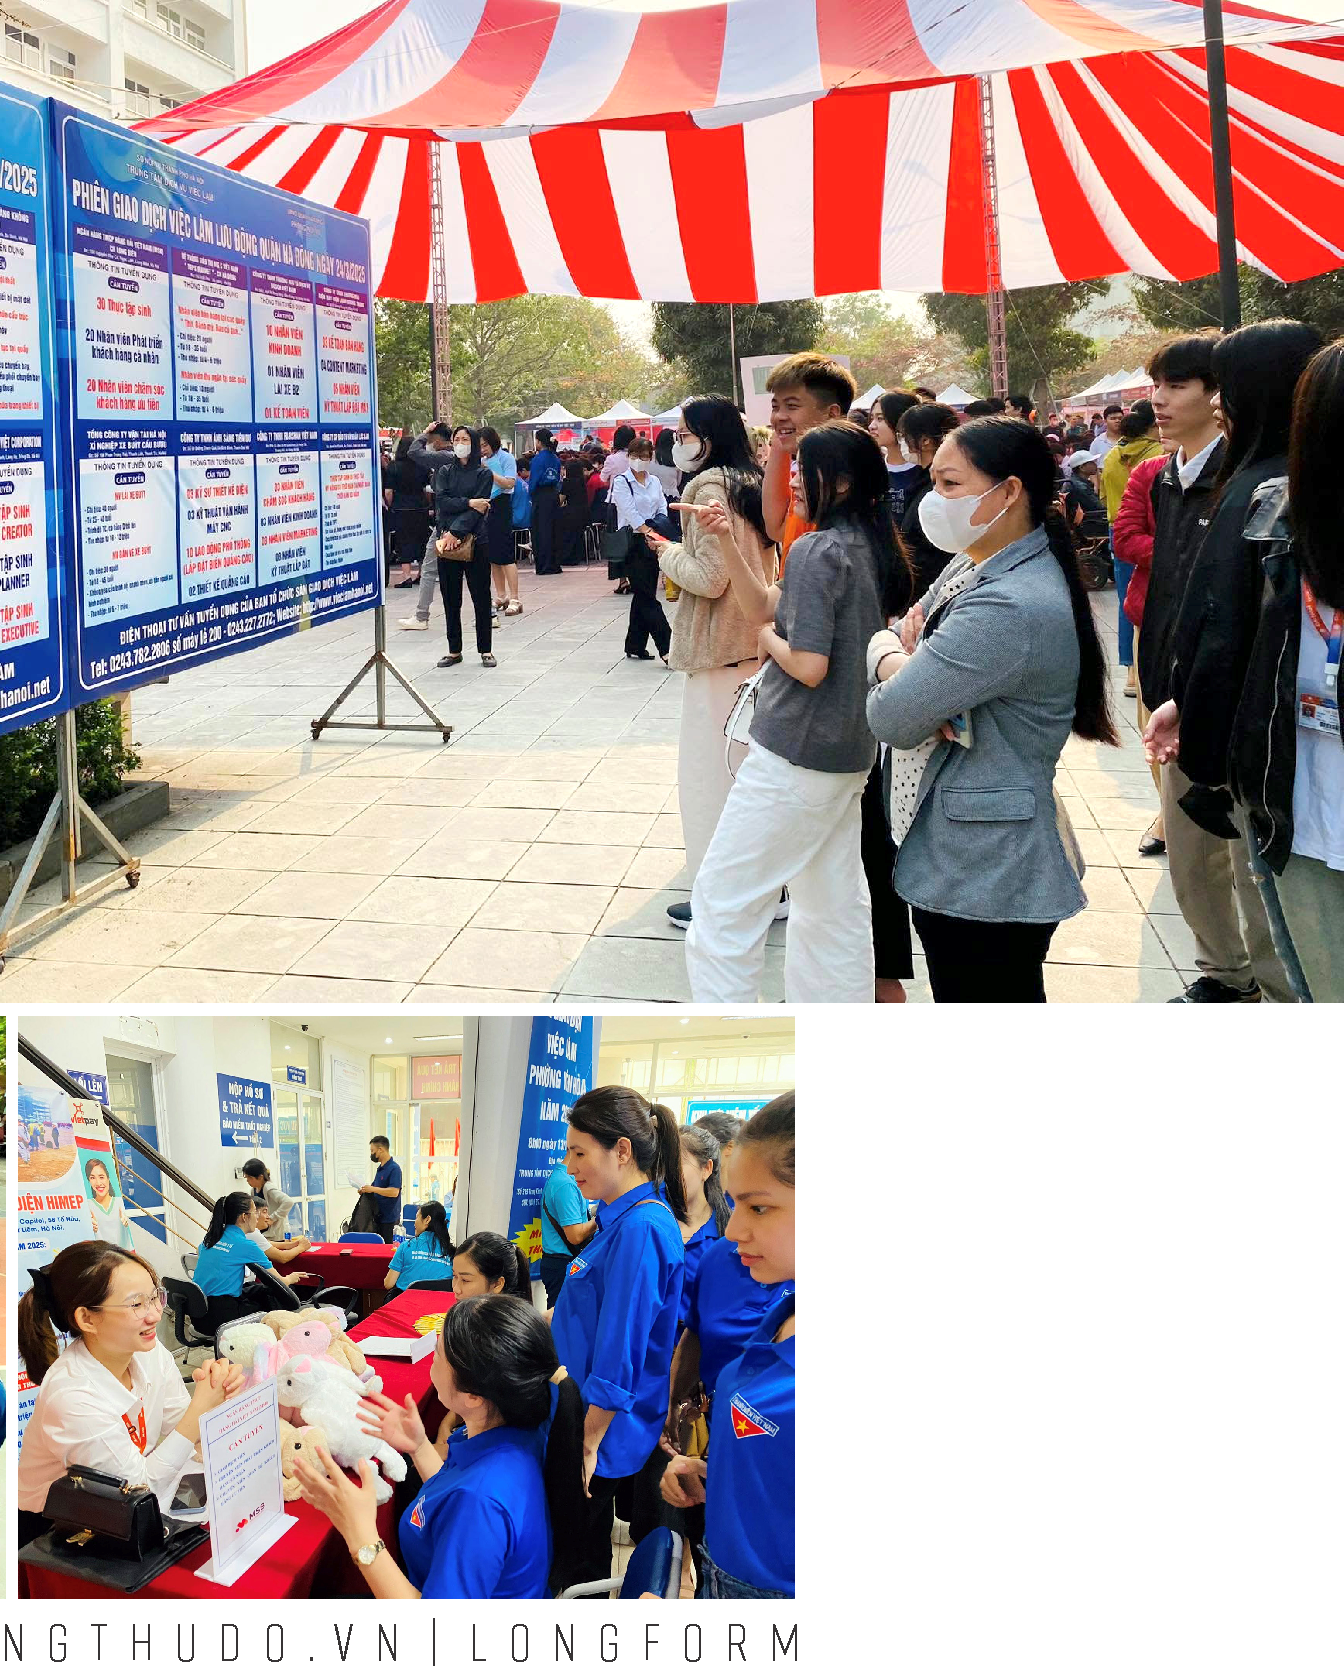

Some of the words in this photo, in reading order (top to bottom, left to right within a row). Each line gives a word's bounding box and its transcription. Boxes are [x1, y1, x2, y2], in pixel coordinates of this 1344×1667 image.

[72, 178, 110, 215] PHIÊN
[113, 191, 139, 223] GIAO
[141, 200, 167, 233] DỊCH
[169, 208, 191, 241] VIỆC
[193, 213, 214, 244] LÀM
[234, 227, 257, 258] ĐỘNG
[260, 236, 281, 266] QUẬN
[283, 241, 294, 266] HÀ
[294, 244, 314, 270] ĐÔNG
[316, 251, 334, 276] NGÀY
[97, 297, 106, 310] 30
[108, 298, 124, 315] Thực
[138, 304, 152, 317] sinh
[13, 504, 30, 519] SINH
[1, 523, 33, 541] CREATOR
[0, 554, 13, 575] TẬP
[16, 553, 33, 569] SINH
[0, 605, 14, 625] TẬP
[16, 602, 34, 620] SINH
[120, 626, 141, 645] ĐIỆN
[142, 619, 166, 639] THOẠI
[168, 617, 179, 632] TƯ
[179, 611, 194, 628] VẤN
[196, 604, 219, 624] TUYỂN
[221, 604, 239, 619] DỤNG
[241, 595, 253, 613] CỦA
[255, 595, 268, 609] BAN
[1, 620, 39, 644] EXECUTIVE
[90, 658, 107, 679] Tel:
[110, 640, 170, 673] 0243.782.2806
[172, 634, 182, 654] số
[183, 634, 198, 651] máy
[88, 1079, 102, 1092] LÊN
[529, 1063, 561, 1089] PHƯỜNG
[229, 1081, 243, 1098] NỘP
[245, 1083, 253, 1098] HỒ
[255, 1088, 263, 1099] SƠ
[222, 1101, 228, 1112] &
[229, 1099, 243, 1114] TRẢ
[244, 1101, 255, 1116] KẾT
[258, 1104, 269, 1117] QUẢ
[539, 1098, 559, 1121] NĂM
[71, 1116, 98, 1126] vietpay
[46, 1195, 83, 1209] HIMEP
